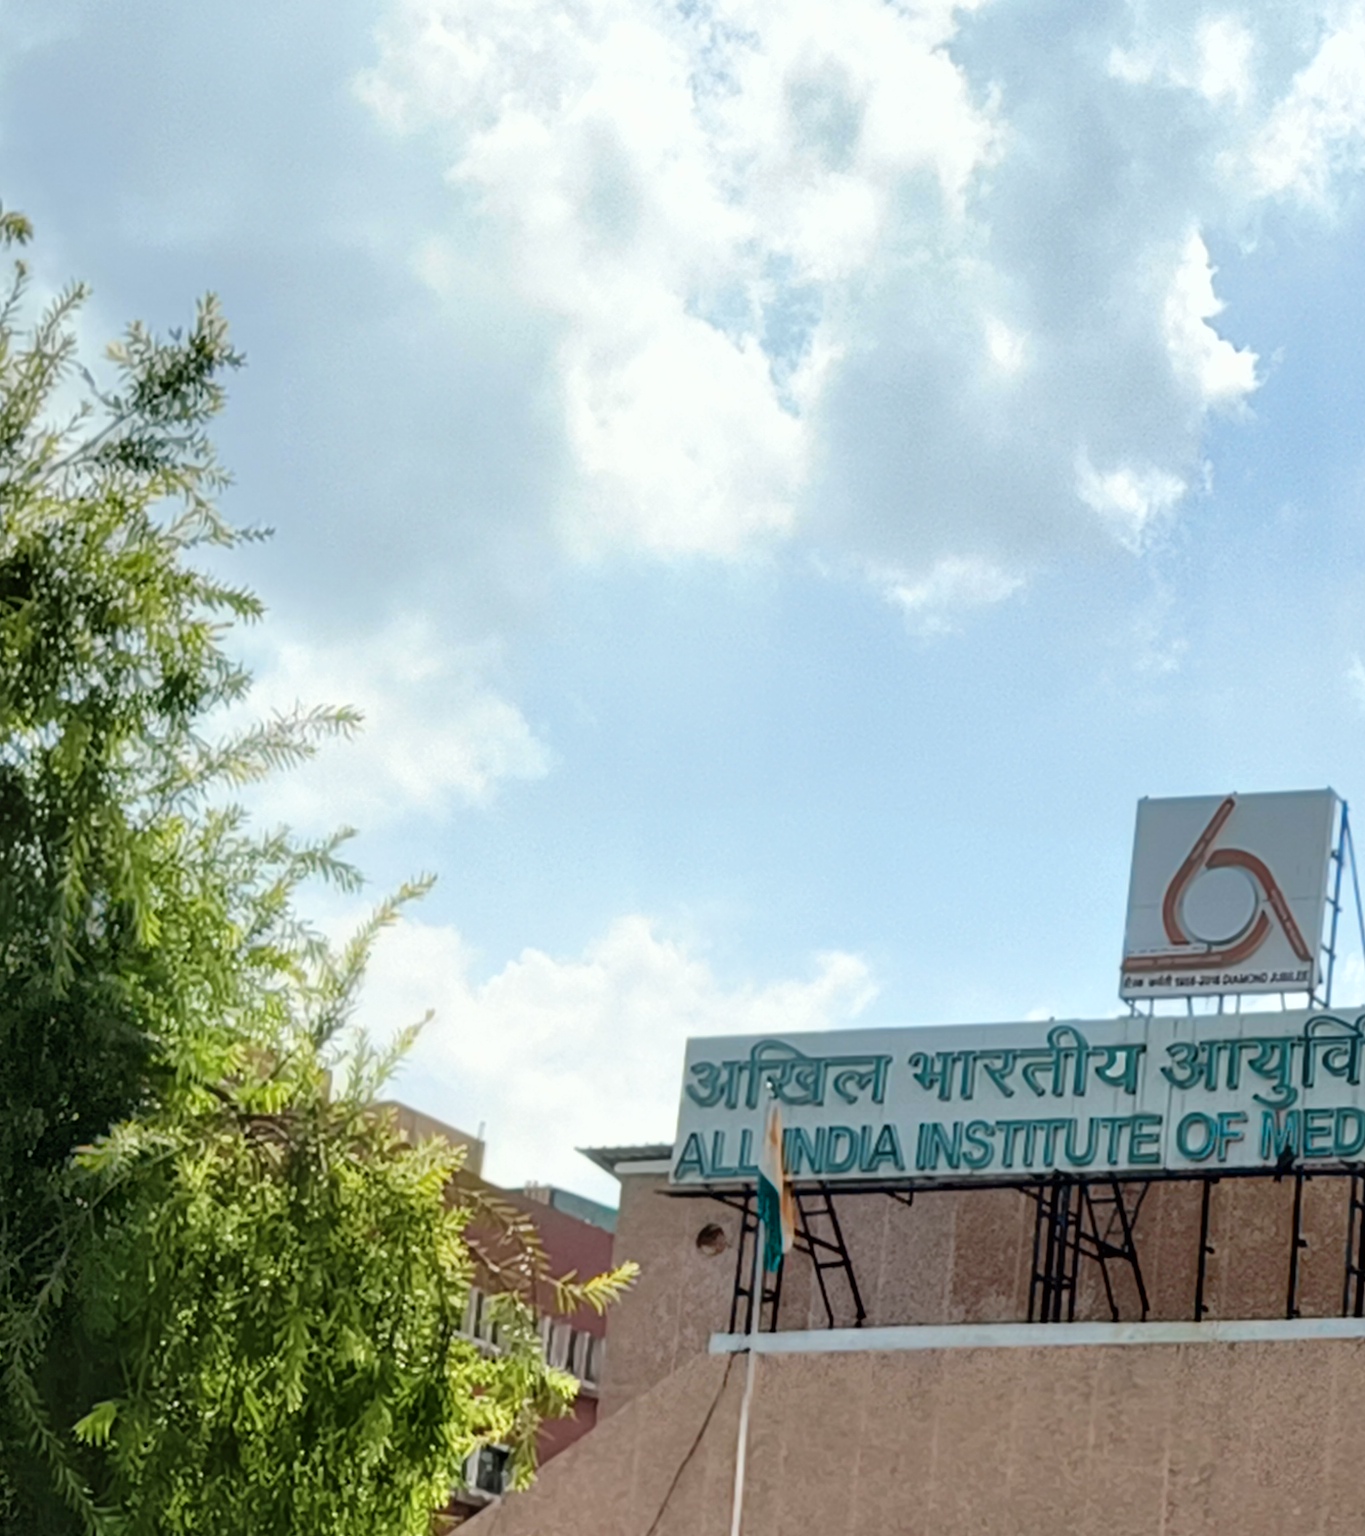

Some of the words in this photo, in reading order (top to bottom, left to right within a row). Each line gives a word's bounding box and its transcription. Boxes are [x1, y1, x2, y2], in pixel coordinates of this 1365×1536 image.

[686, 1039, 893, 1111] अखिल
[908, 1025, 1147, 1100] भारतीय
[674, 1127, 760, 1181] ALL
[783, 1122, 906, 1177] INDIA
[915, 1113, 1164, 1171] INSTITUTE
[1175, 1110, 1248, 1163] OF
